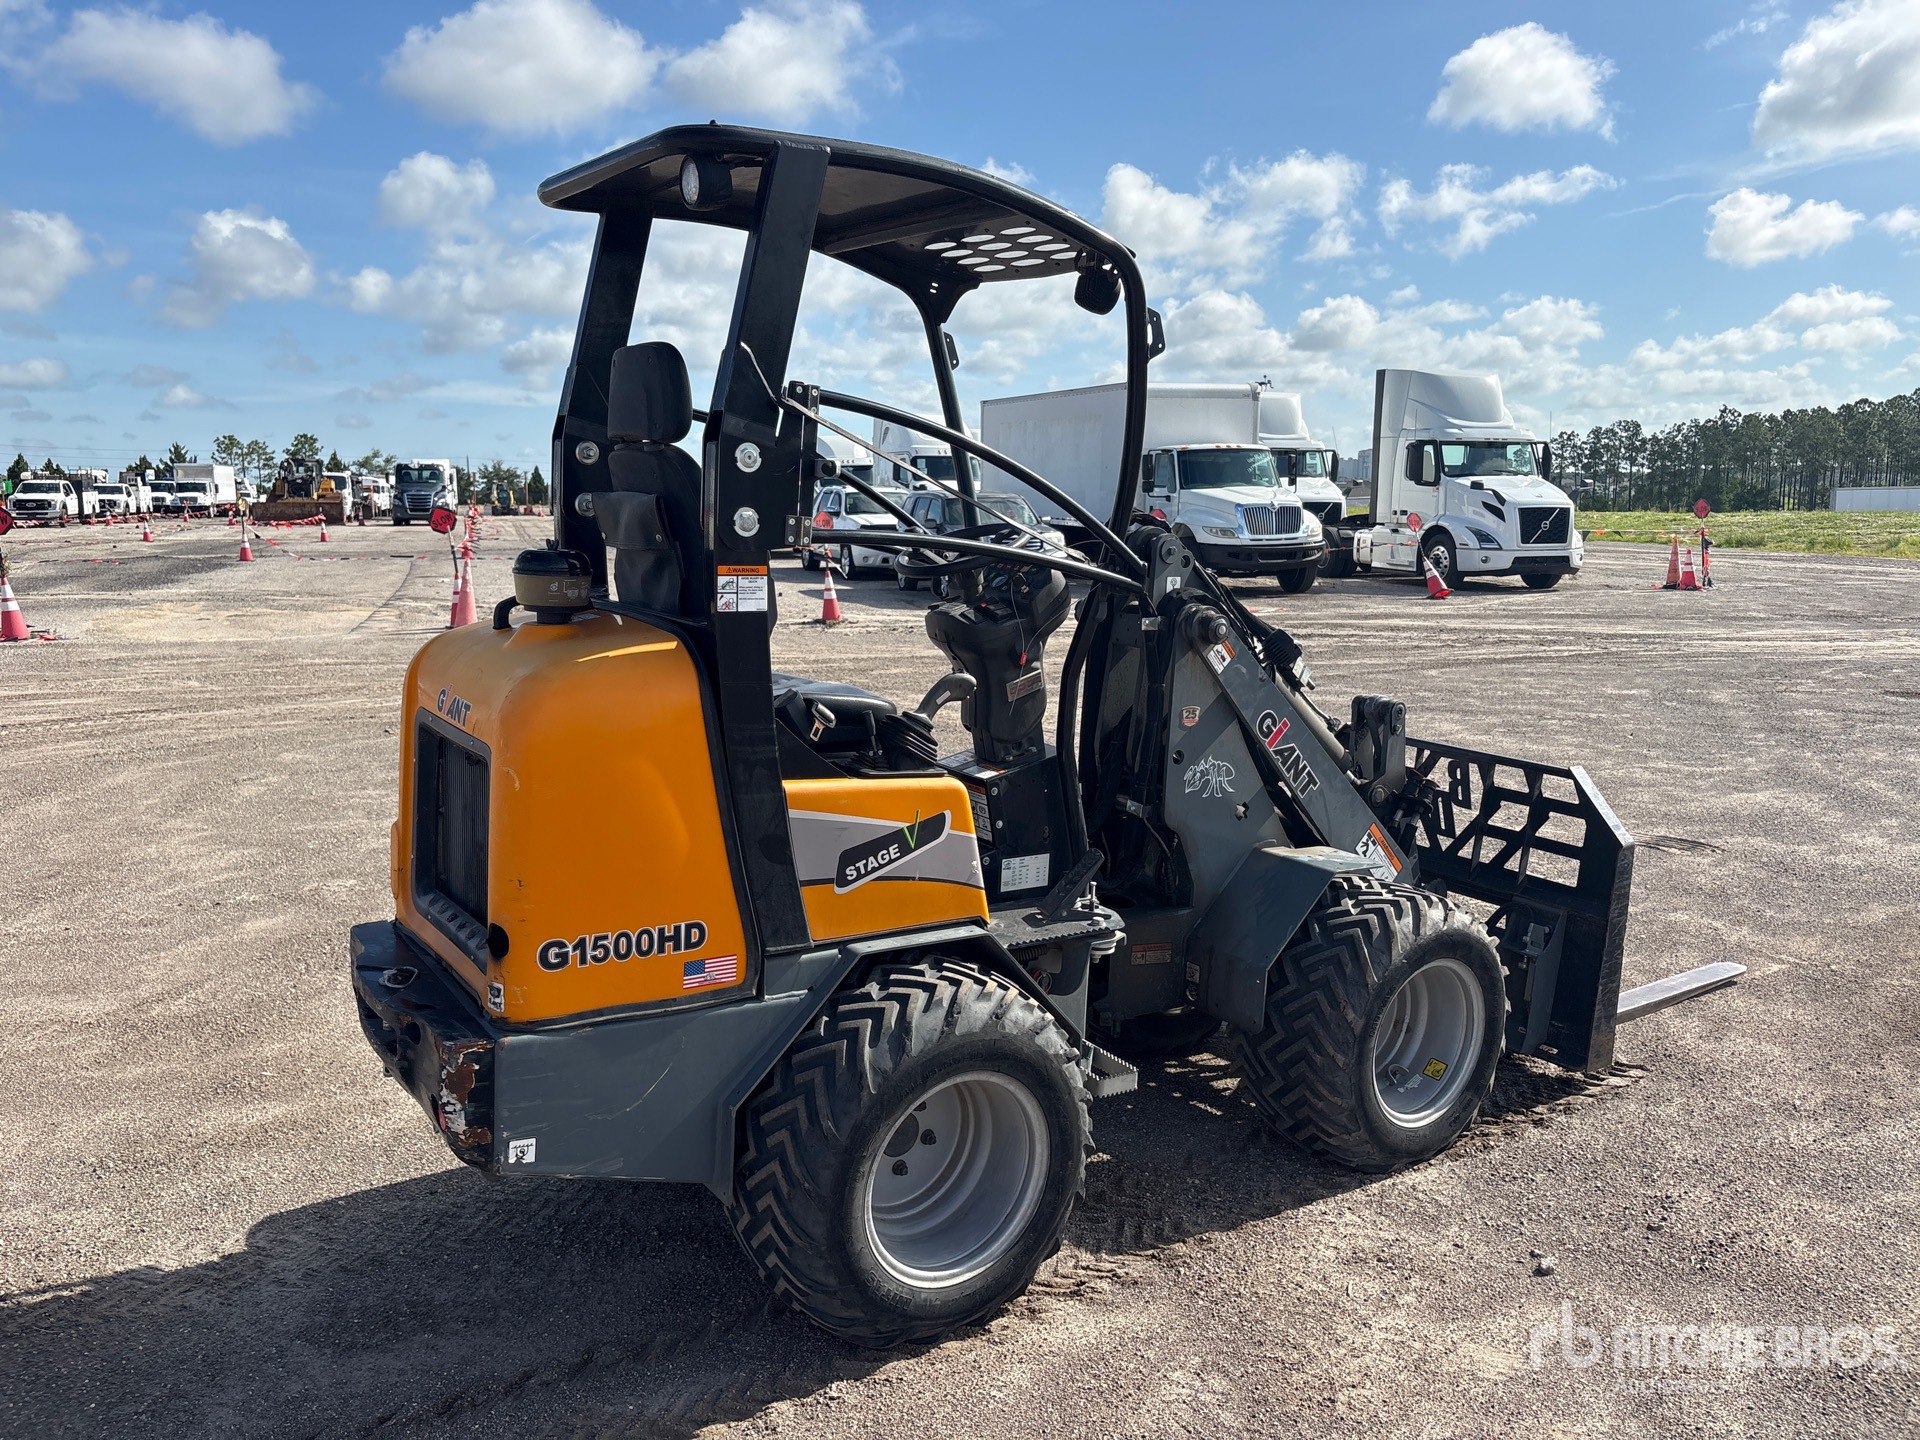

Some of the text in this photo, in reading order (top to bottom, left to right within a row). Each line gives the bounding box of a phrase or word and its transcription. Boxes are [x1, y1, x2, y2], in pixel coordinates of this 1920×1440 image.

[432, 514, 453, 528] SLOW
[815, 519, 831, 528] SLOW
[437, 683, 472, 729] GIANT
[1184, 709, 1198, 720] 25
[1256, 709, 1320, 798] GIANT
[845, 843, 901, 881] STAGE
[536, 920, 708, 973] G1500HD
